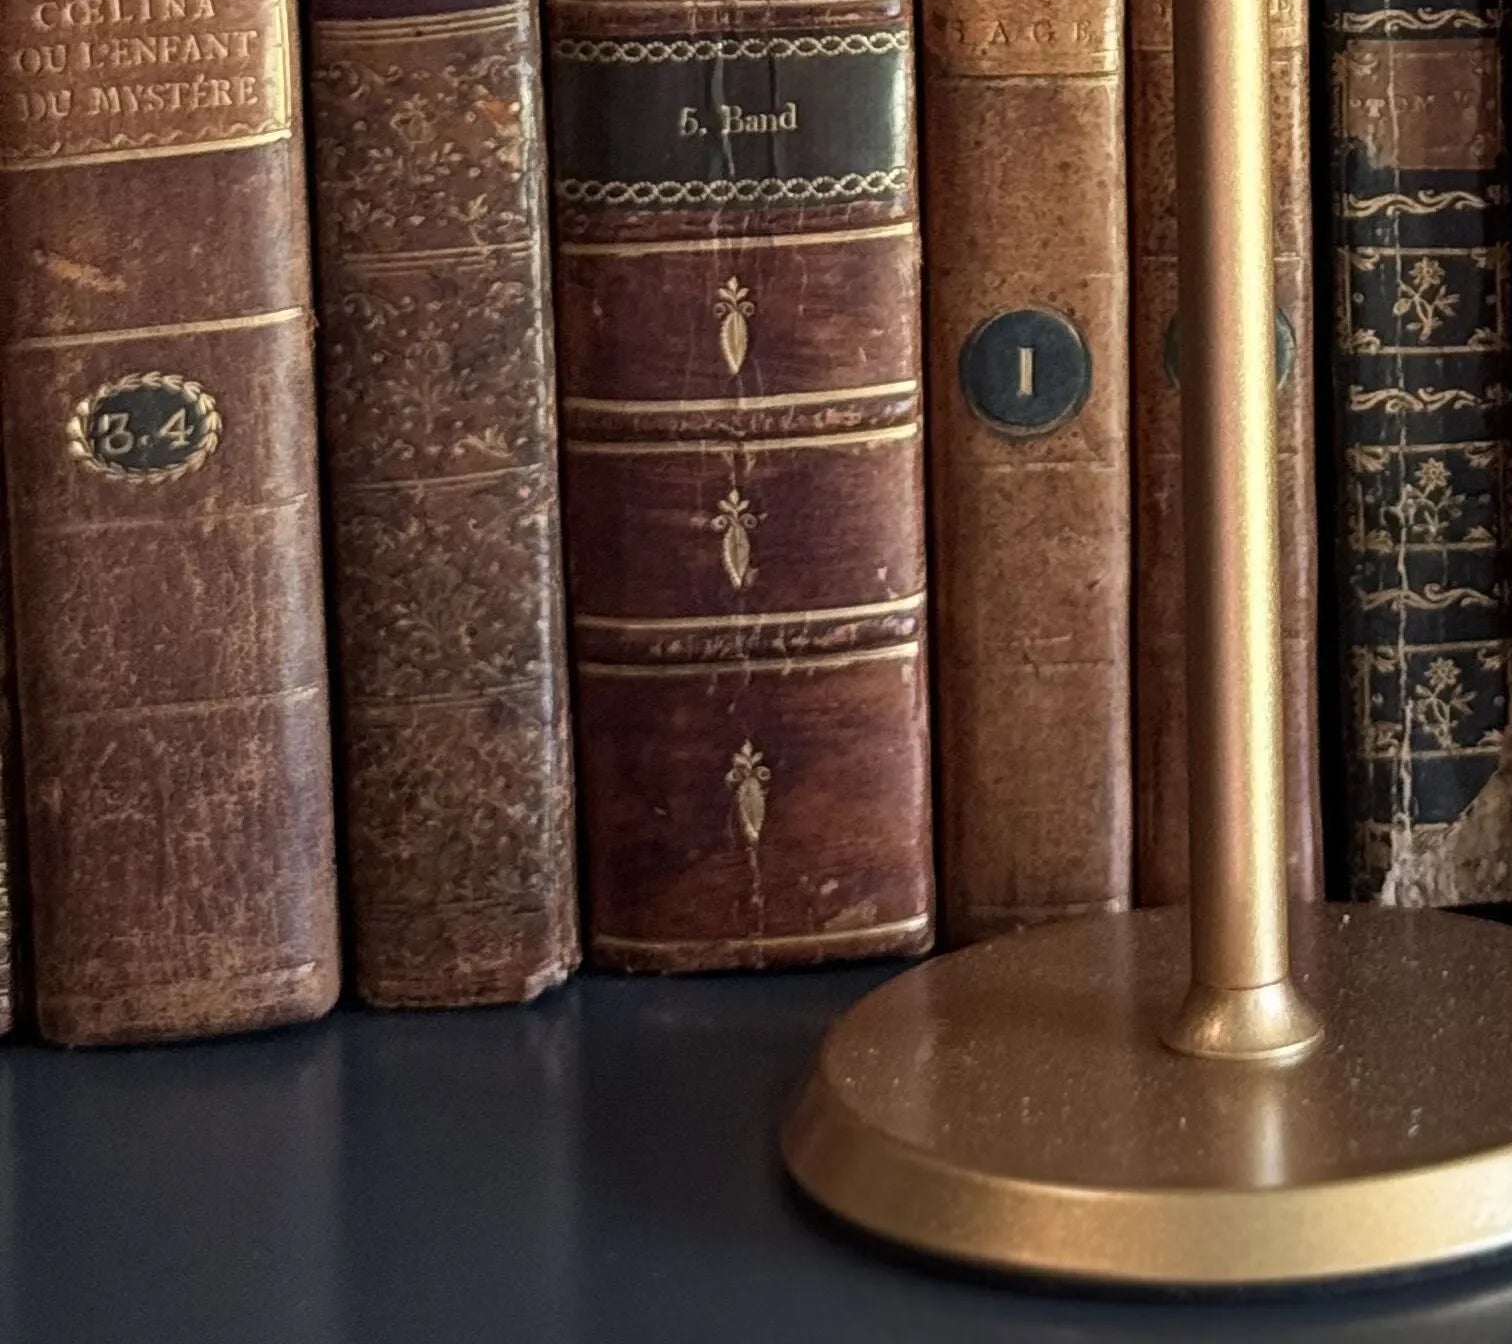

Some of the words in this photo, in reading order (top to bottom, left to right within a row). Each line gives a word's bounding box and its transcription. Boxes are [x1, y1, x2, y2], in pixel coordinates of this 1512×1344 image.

[13, 43, 68, 76] OU
[76, 30, 258, 71] L'ENFANT
[17, 89, 72, 122] DU
[679, 106, 708, 137] 5.
[720, 101, 799, 136] Band
